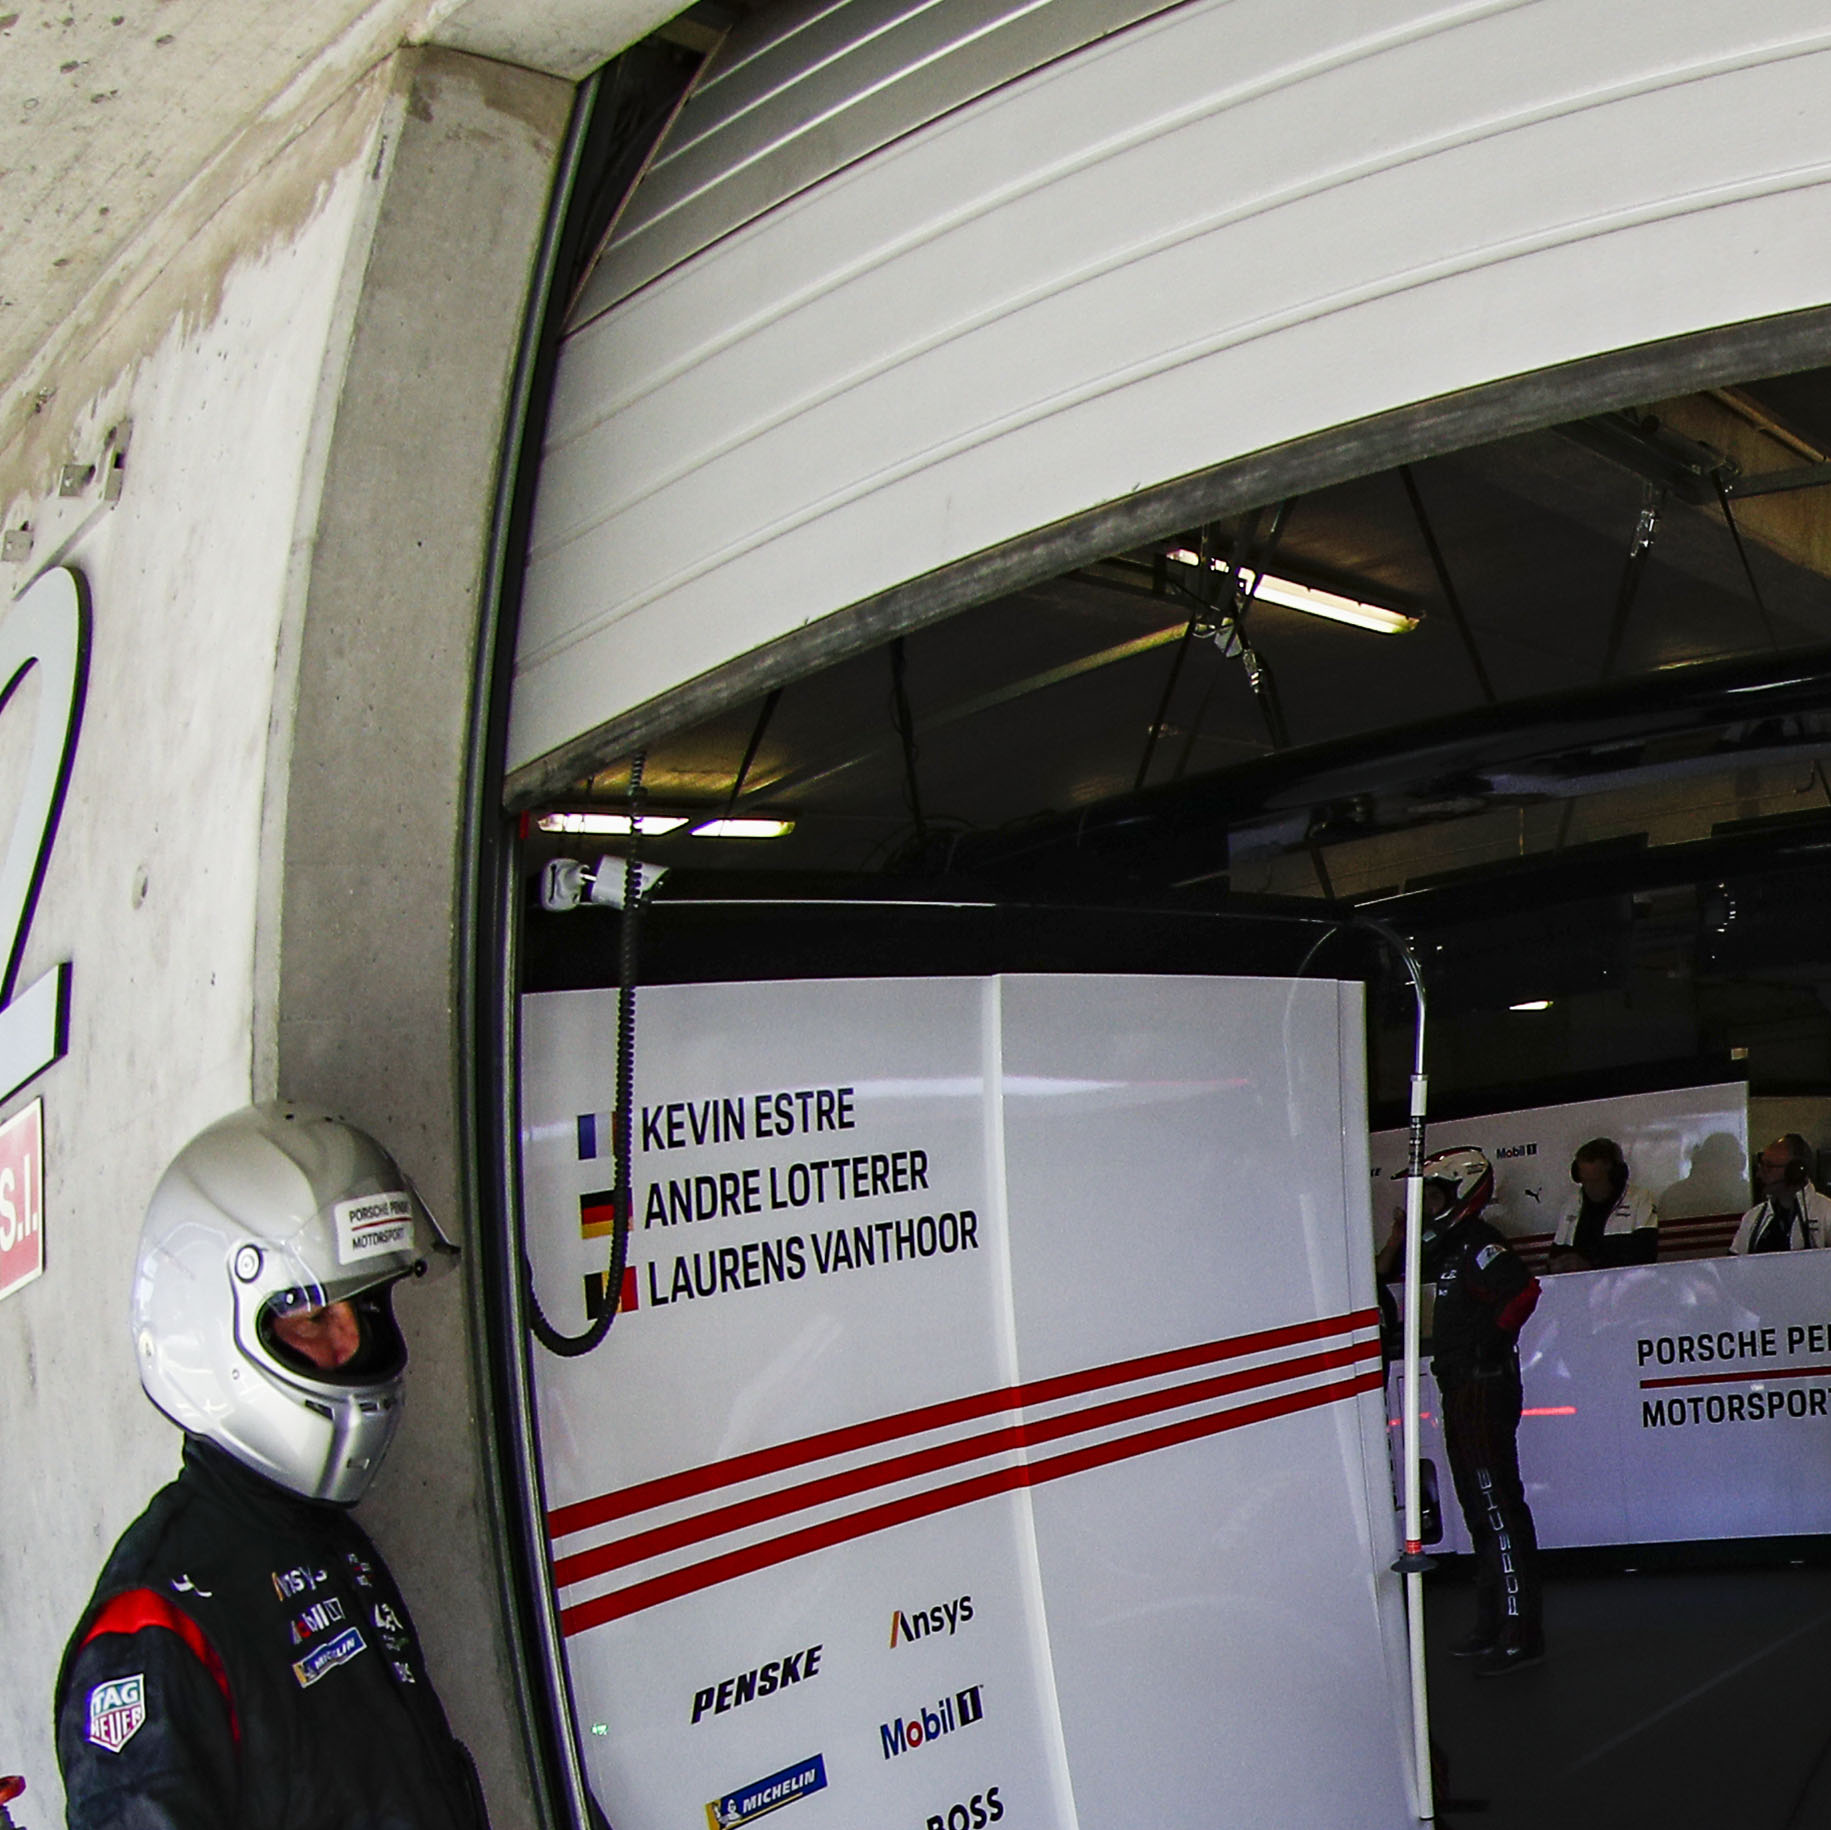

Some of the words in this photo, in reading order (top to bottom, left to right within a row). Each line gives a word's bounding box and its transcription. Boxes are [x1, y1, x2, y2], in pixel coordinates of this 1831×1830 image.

[642, 1097, 745, 1152] KEVIN
[755, 1088, 855, 1138] ESTRE
[644, 1169, 761, 1229] ANDRE
[769, 1150, 929, 1210] LOTTERER
[648, 1236, 804, 1306] LAURENS
[811, 1210, 978, 1274] VANTHOOR
[1637, 1328, 1777, 1366] PORSCHE
[1477, 1467, 1519, 1616] PORSCHE
[890, 1596, 974, 1649] Ansys
[93, 1682, 138, 1716] TAG
[691, 1644, 823, 1725] PENSKE
[91, 1706, 141, 1744] HEUER
[880, 1697, 954, 1759] Mobil
[742, 1768, 816, 1813] MICHELIN
